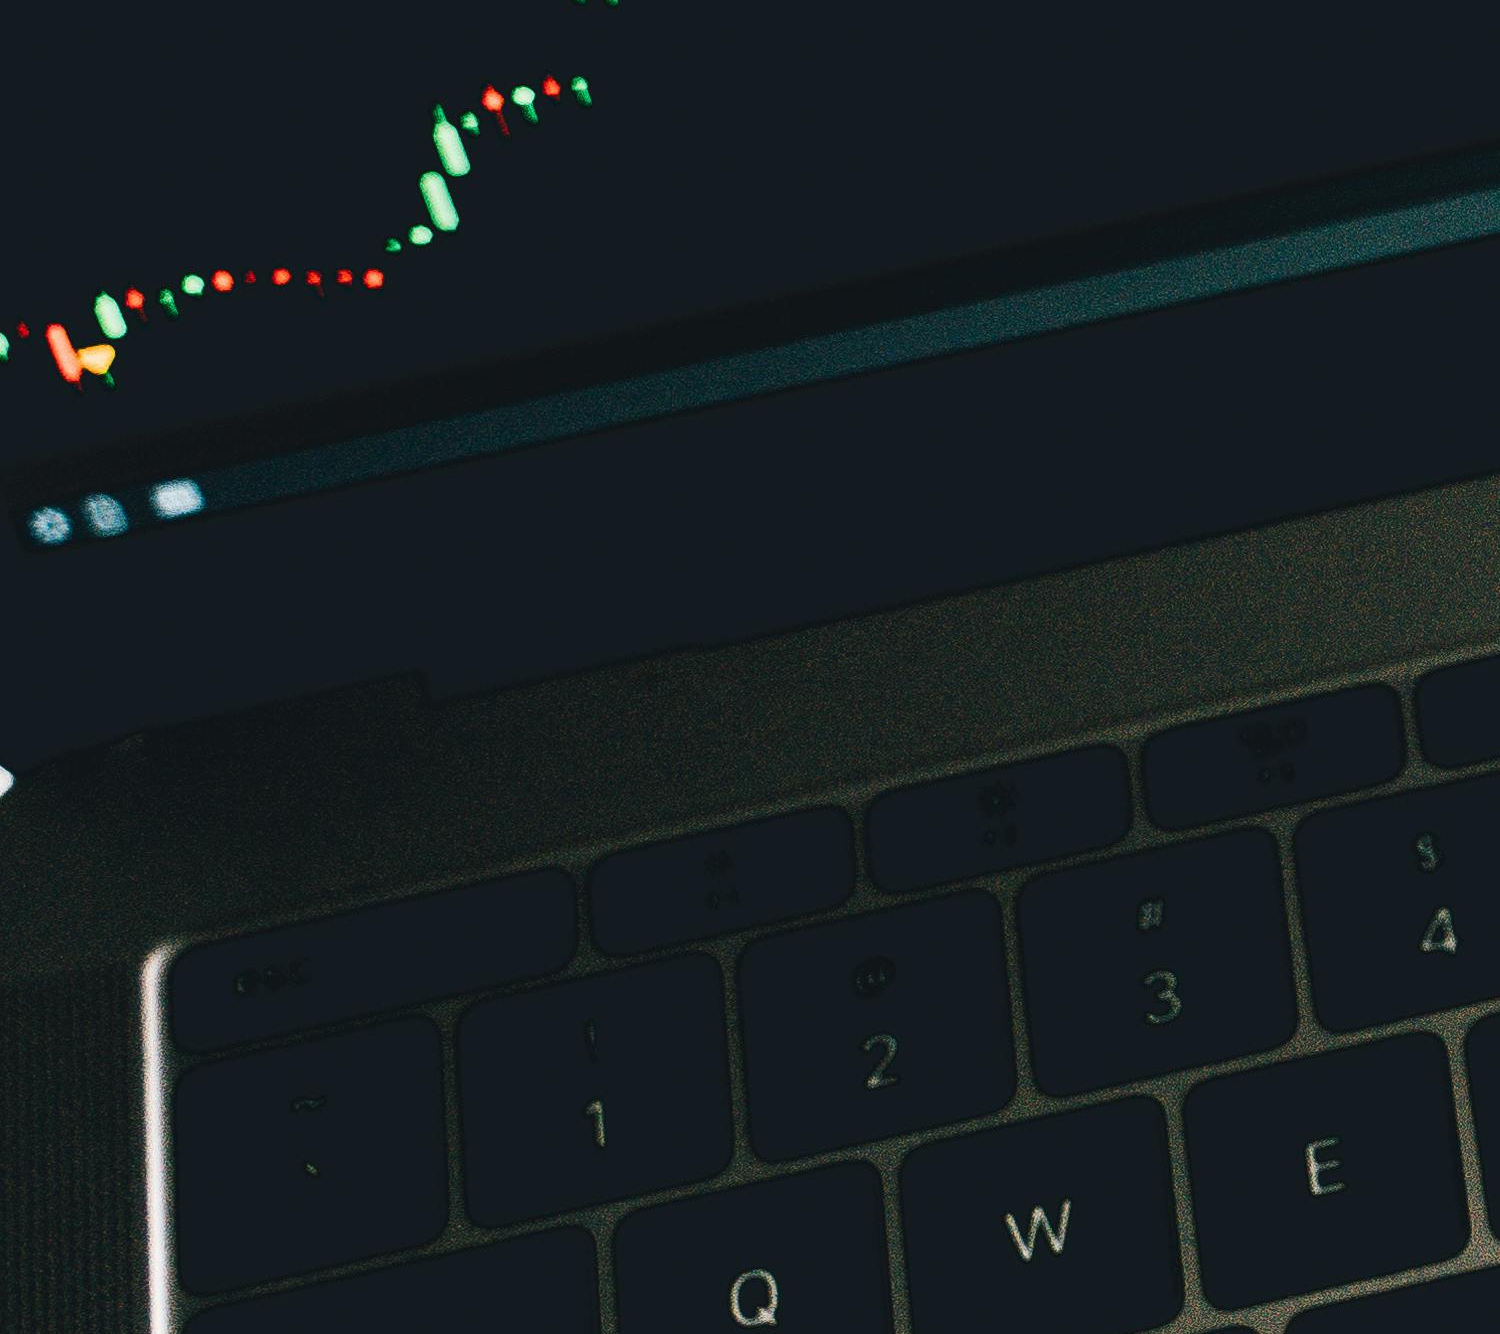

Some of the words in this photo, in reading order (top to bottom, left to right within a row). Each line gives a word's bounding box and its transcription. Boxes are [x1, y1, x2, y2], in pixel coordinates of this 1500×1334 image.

[1422, 909, 1457, 951] 4
[1147, 972, 1182, 1023] 3
[863, 1034, 902, 1091] 2
[1304, 1137, 1348, 1197] E
[1006, 1202, 1071, 1260] W
[731, 1271, 778, 1326] Q
